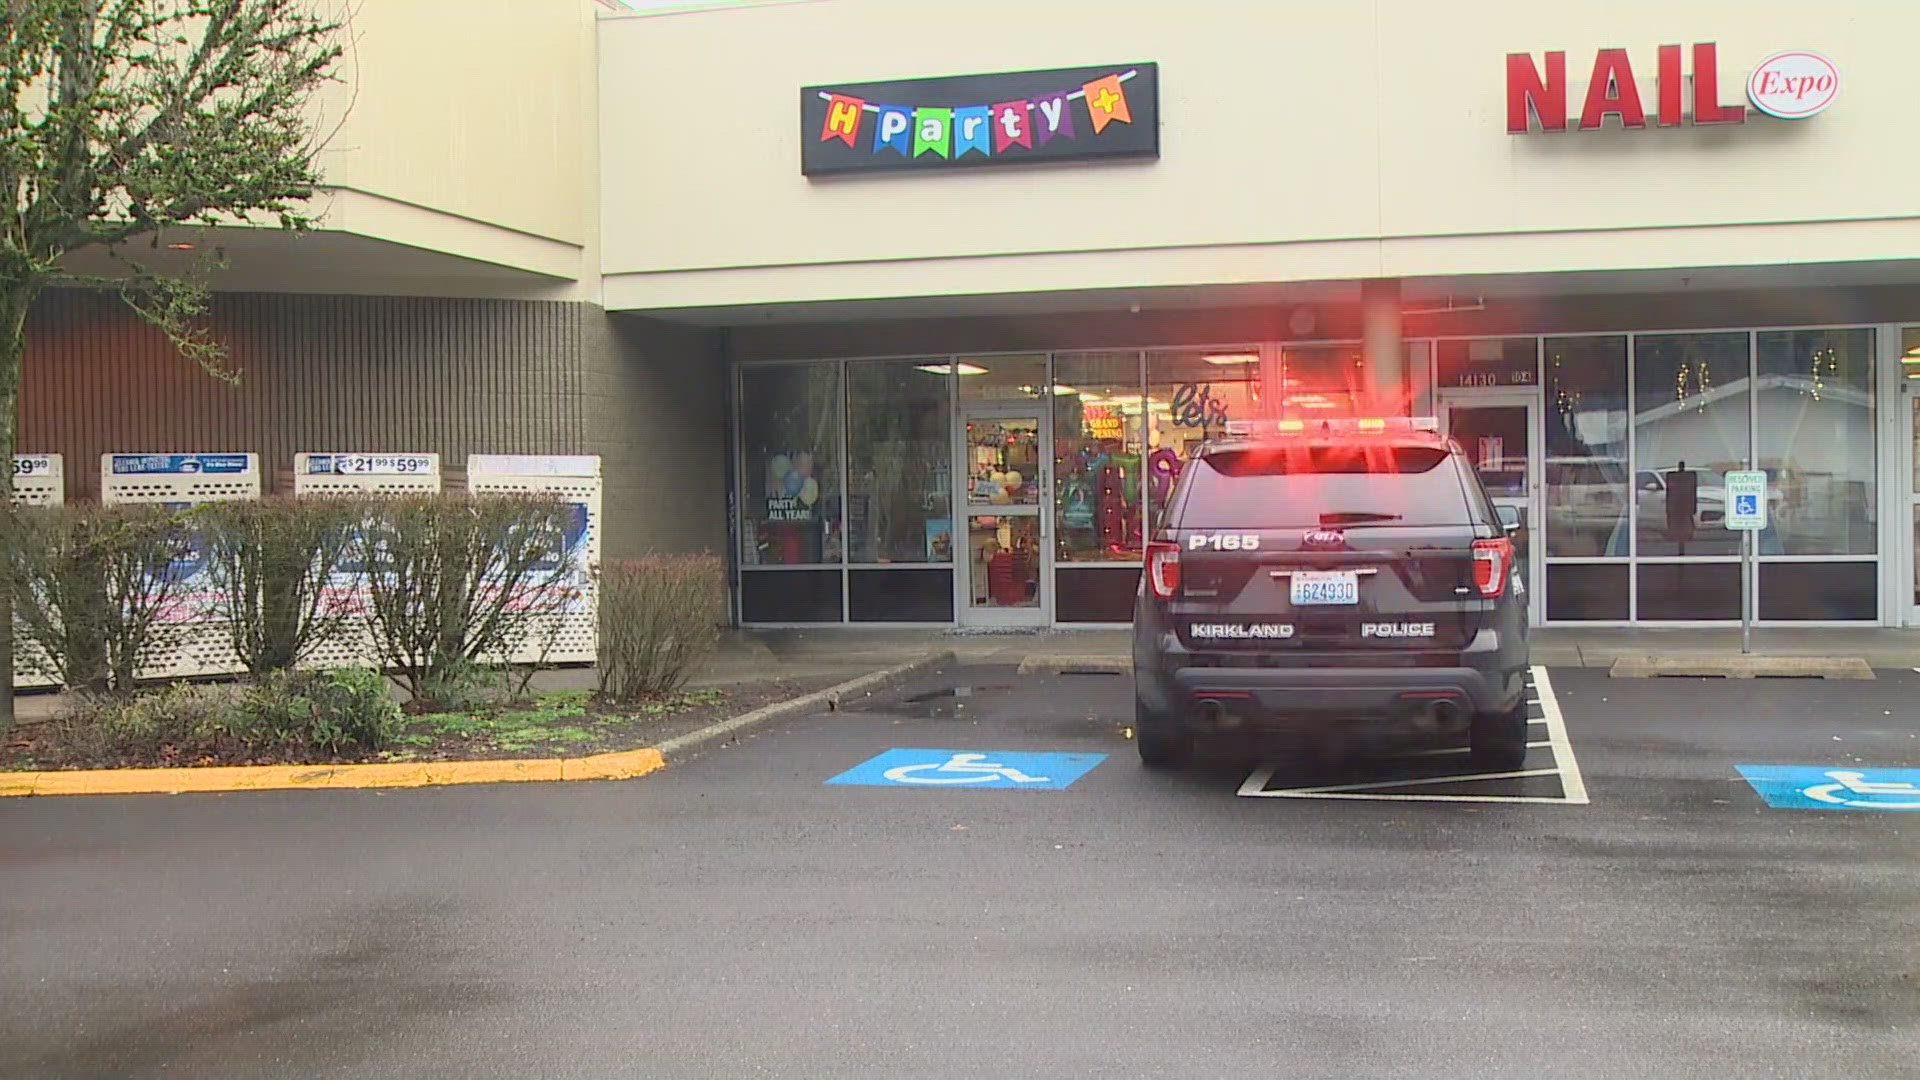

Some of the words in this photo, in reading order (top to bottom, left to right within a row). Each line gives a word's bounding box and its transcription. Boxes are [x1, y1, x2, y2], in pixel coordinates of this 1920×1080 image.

[1505, 41, 1747, 134] NAIL
[1758, 69, 1833, 100] Expo
[828, 98, 857, 135] H
[881, 96, 1063, 143] Party
[1460, 373, 1496, 387] 14130
[1089, 418, 1119, 429] GRAND
[1728, 474, 1763, 484] RESERVED
[1731, 484, 1761, 493] PARKING
[769, 510, 784, 521] ALL
[1189, 534, 1260, 551] P165
[1190, 623, 1294, 639] KIRKLAND
[1361, 622, 1435, 638] POLICE
